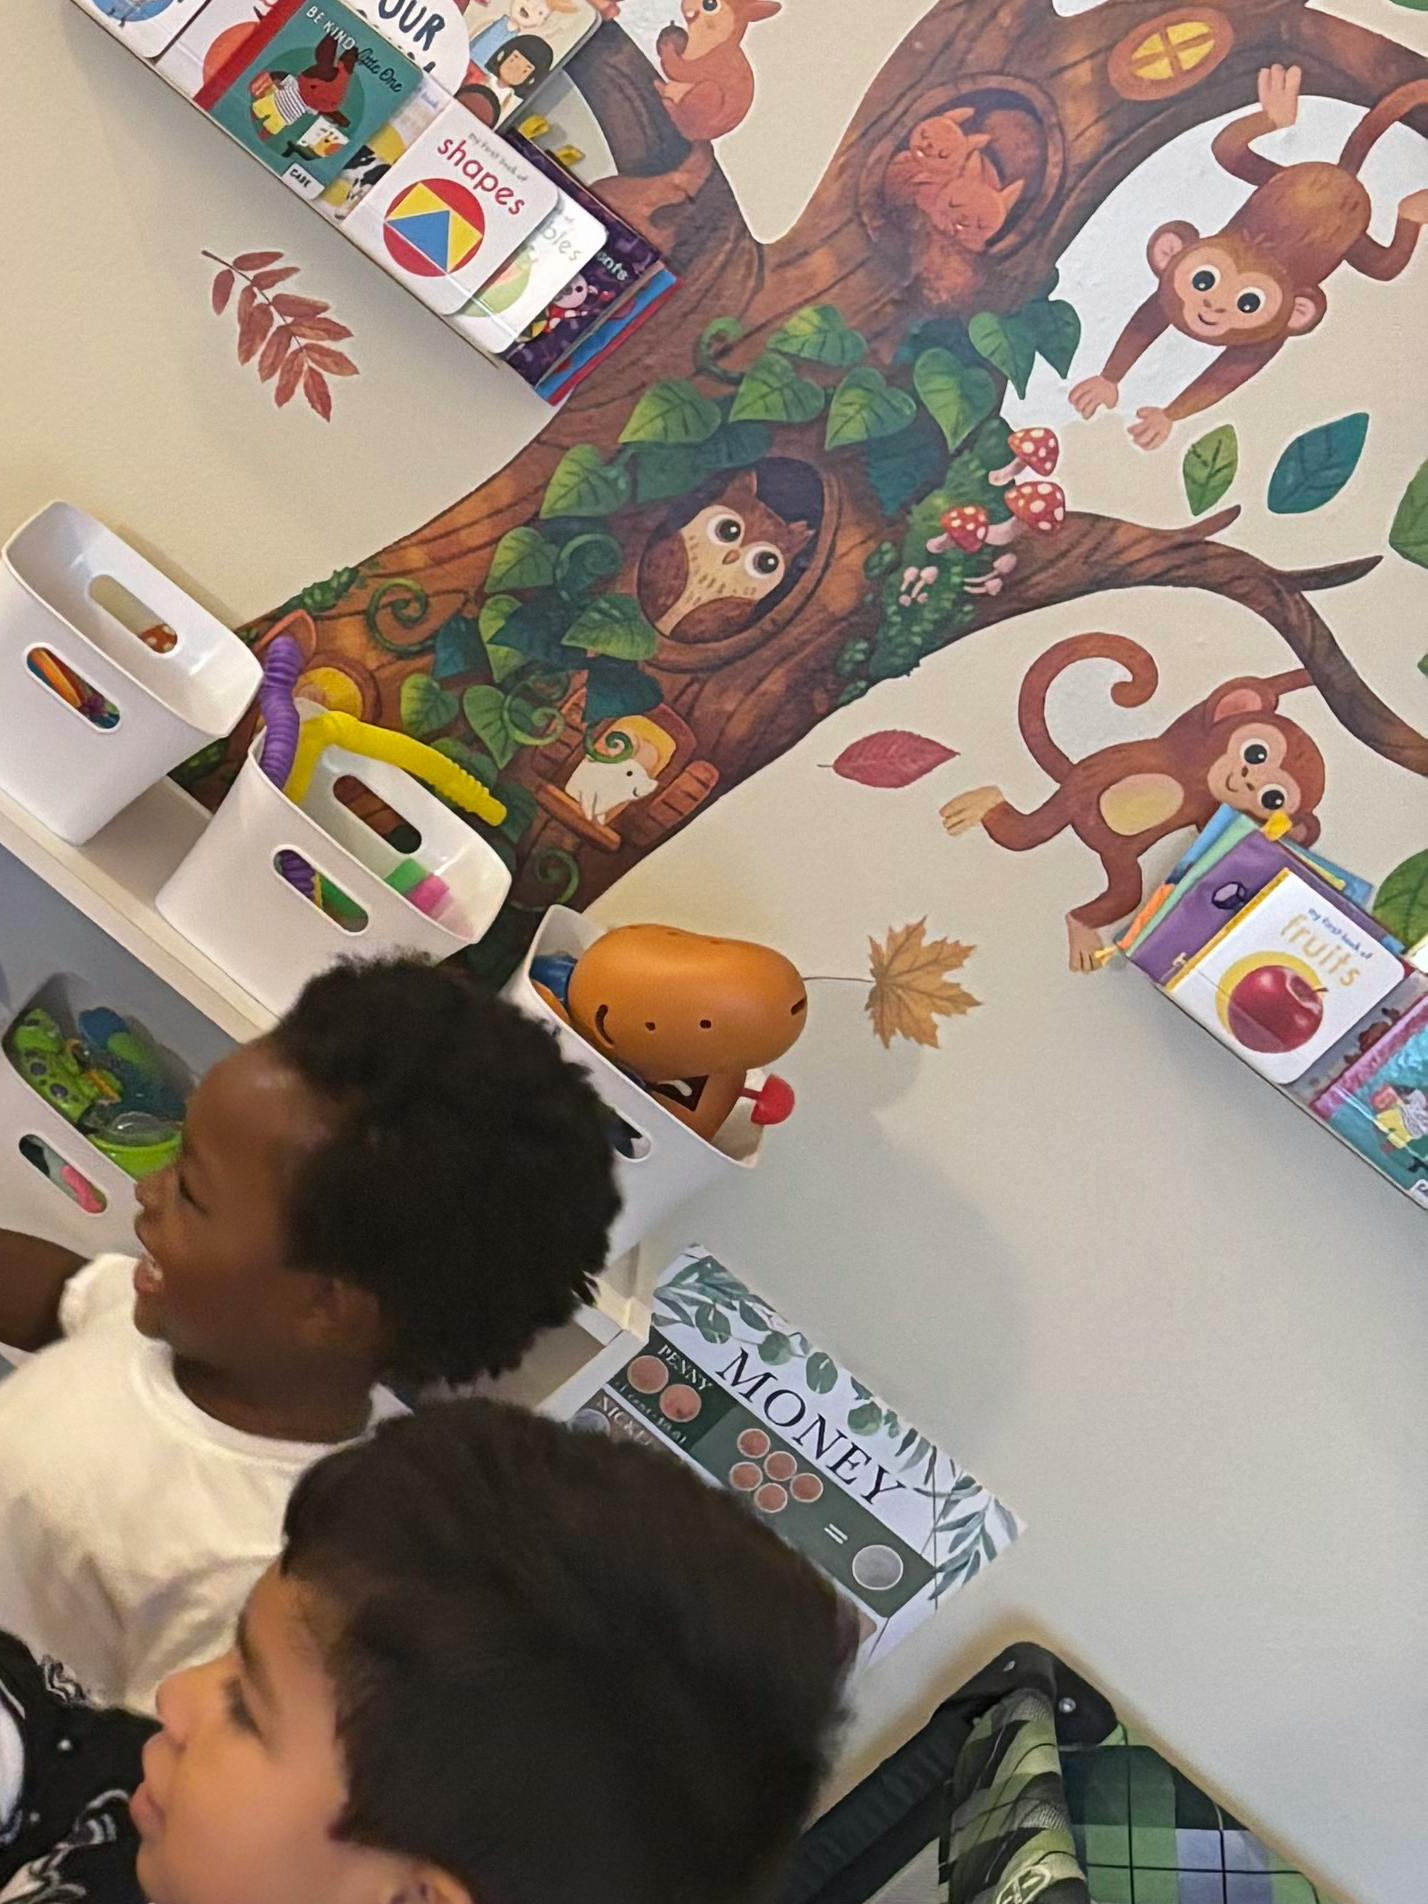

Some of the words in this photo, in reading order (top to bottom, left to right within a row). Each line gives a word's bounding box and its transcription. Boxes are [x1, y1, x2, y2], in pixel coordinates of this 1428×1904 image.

[306, 4, 323, 23] BE
[323, 20, 356, 53] KIND
[437, 138, 524, 215] shapes
[479, 142, 500, 160] first
[1281, 910, 1361, 988] fruits
[1306, 907, 1322, 923] my
[1320, 916, 1343, 936] first
[1340, 932, 1362, 953] book
[1359, 948, 1374, 962] of
[658, 1344, 712, 1391] PENNY
[717, 1349, 904, 1506] MONEY
